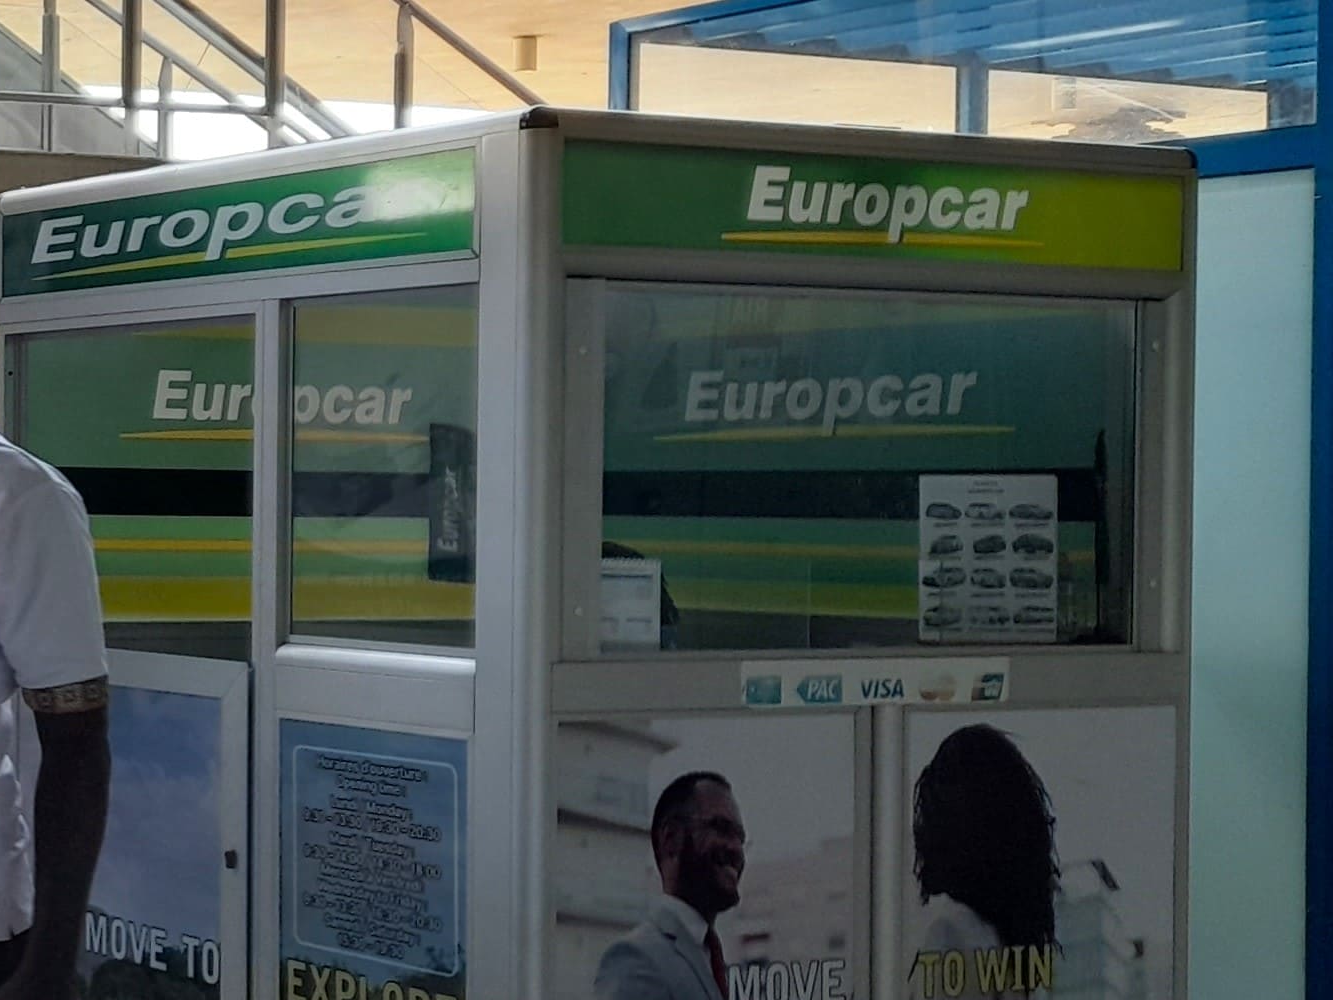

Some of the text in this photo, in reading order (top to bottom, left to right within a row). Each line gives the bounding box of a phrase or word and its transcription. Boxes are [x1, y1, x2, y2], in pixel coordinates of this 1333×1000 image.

[30, 183, 407, 264] Europca
[747, 165, 1030, 244] Europcar
[685, 370, 978, 437] Europcar
[861, 678, 905, 699] VISA
[85, 911, 220, 985] MOVE TO
[917, 951, 965, 999] TO
[974, 943, 1053, 993] WIN
